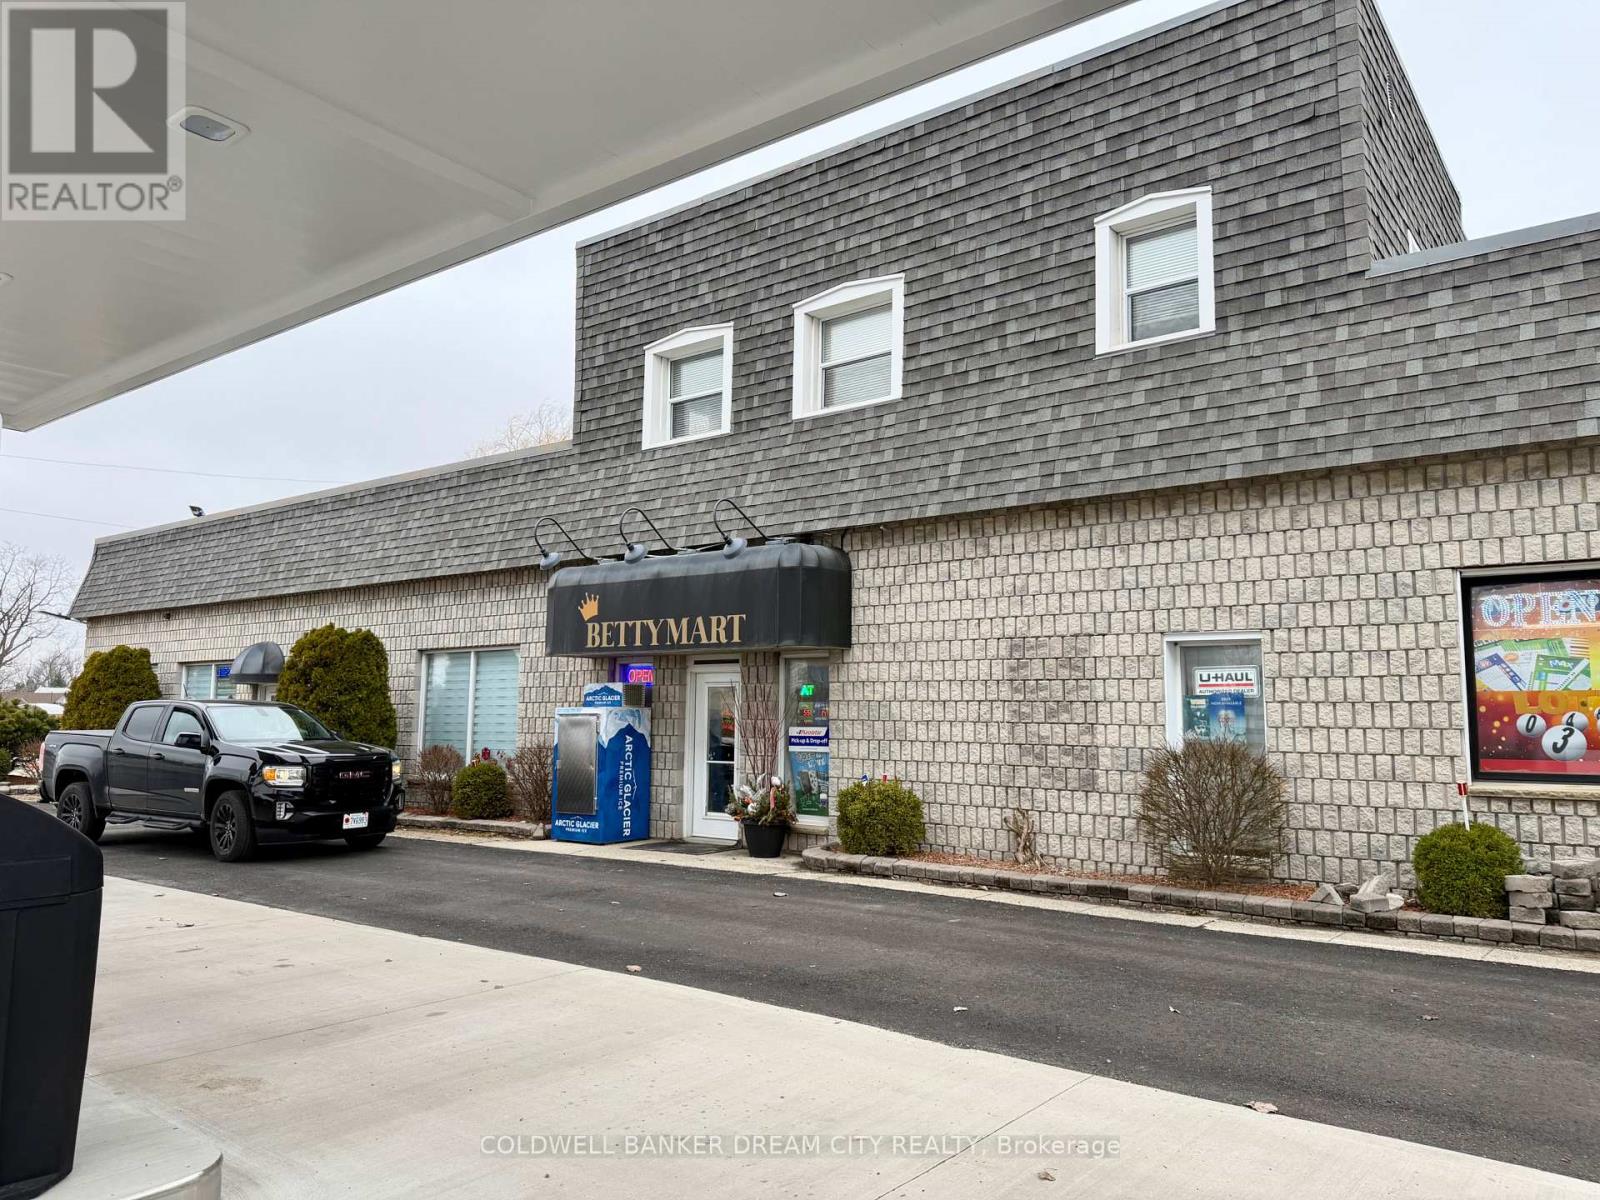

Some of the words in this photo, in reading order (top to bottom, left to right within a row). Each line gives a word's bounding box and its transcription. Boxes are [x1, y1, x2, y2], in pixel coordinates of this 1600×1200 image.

[585, 613, 747, 648] BETTYMART
[628, 669, 654, 683] OPEN
[1552, 726, 1575, 754] 3
[624, 735, 633, 780] ARCTIC
[555, 819, 575, 828] ARCTIC
[575, 820, 599, 829] GLACIER
[622, 784, 632, 837] GLACIER
